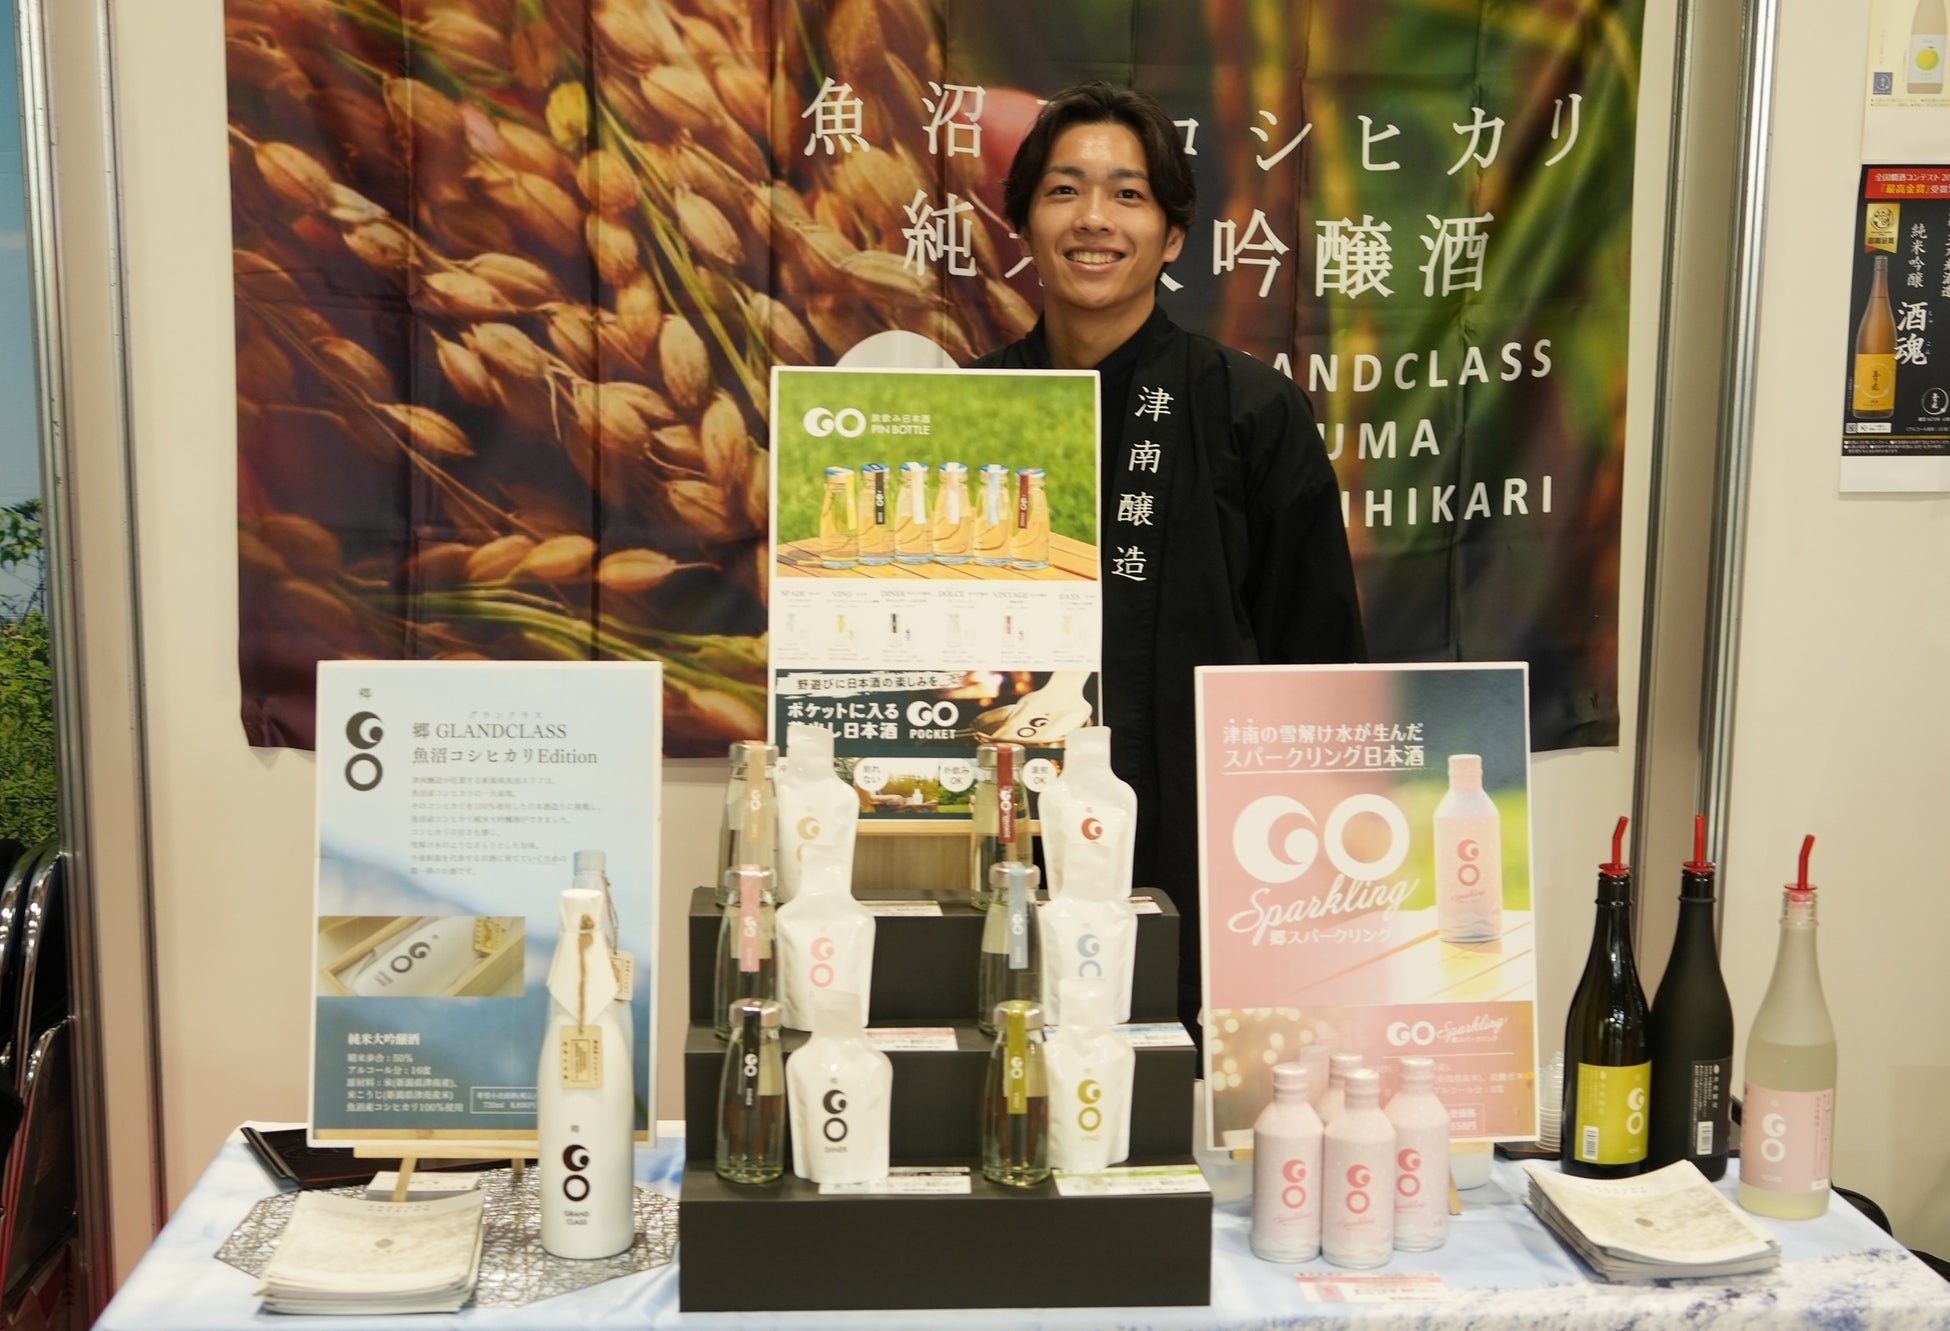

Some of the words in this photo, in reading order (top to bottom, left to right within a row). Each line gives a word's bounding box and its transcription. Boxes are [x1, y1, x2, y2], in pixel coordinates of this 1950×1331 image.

[901, 189, 1494, 299] 純吟醸酒
[1893, 301, 1929, 366] 酒魂
[1241, 339, 1552, 392] ANDCLASS
[892, 425, 931, 435] BOTTLE
[1112, 385, 1174, 582] 津南醸造
[787, 701, 900, 719] ポケットに入る
[435, 723, 568, 739] GLANDCLASS
[787, 721, 899, 739] し日本酒
[909, 729, 957, 740] POCKET
[1223, 721, 1424, 744] 津南の雪解け水が生んだ
[1223, 744, 1425, 768] スパークリング日本酒
[1228, 872, 1420, 946] Sparkling
